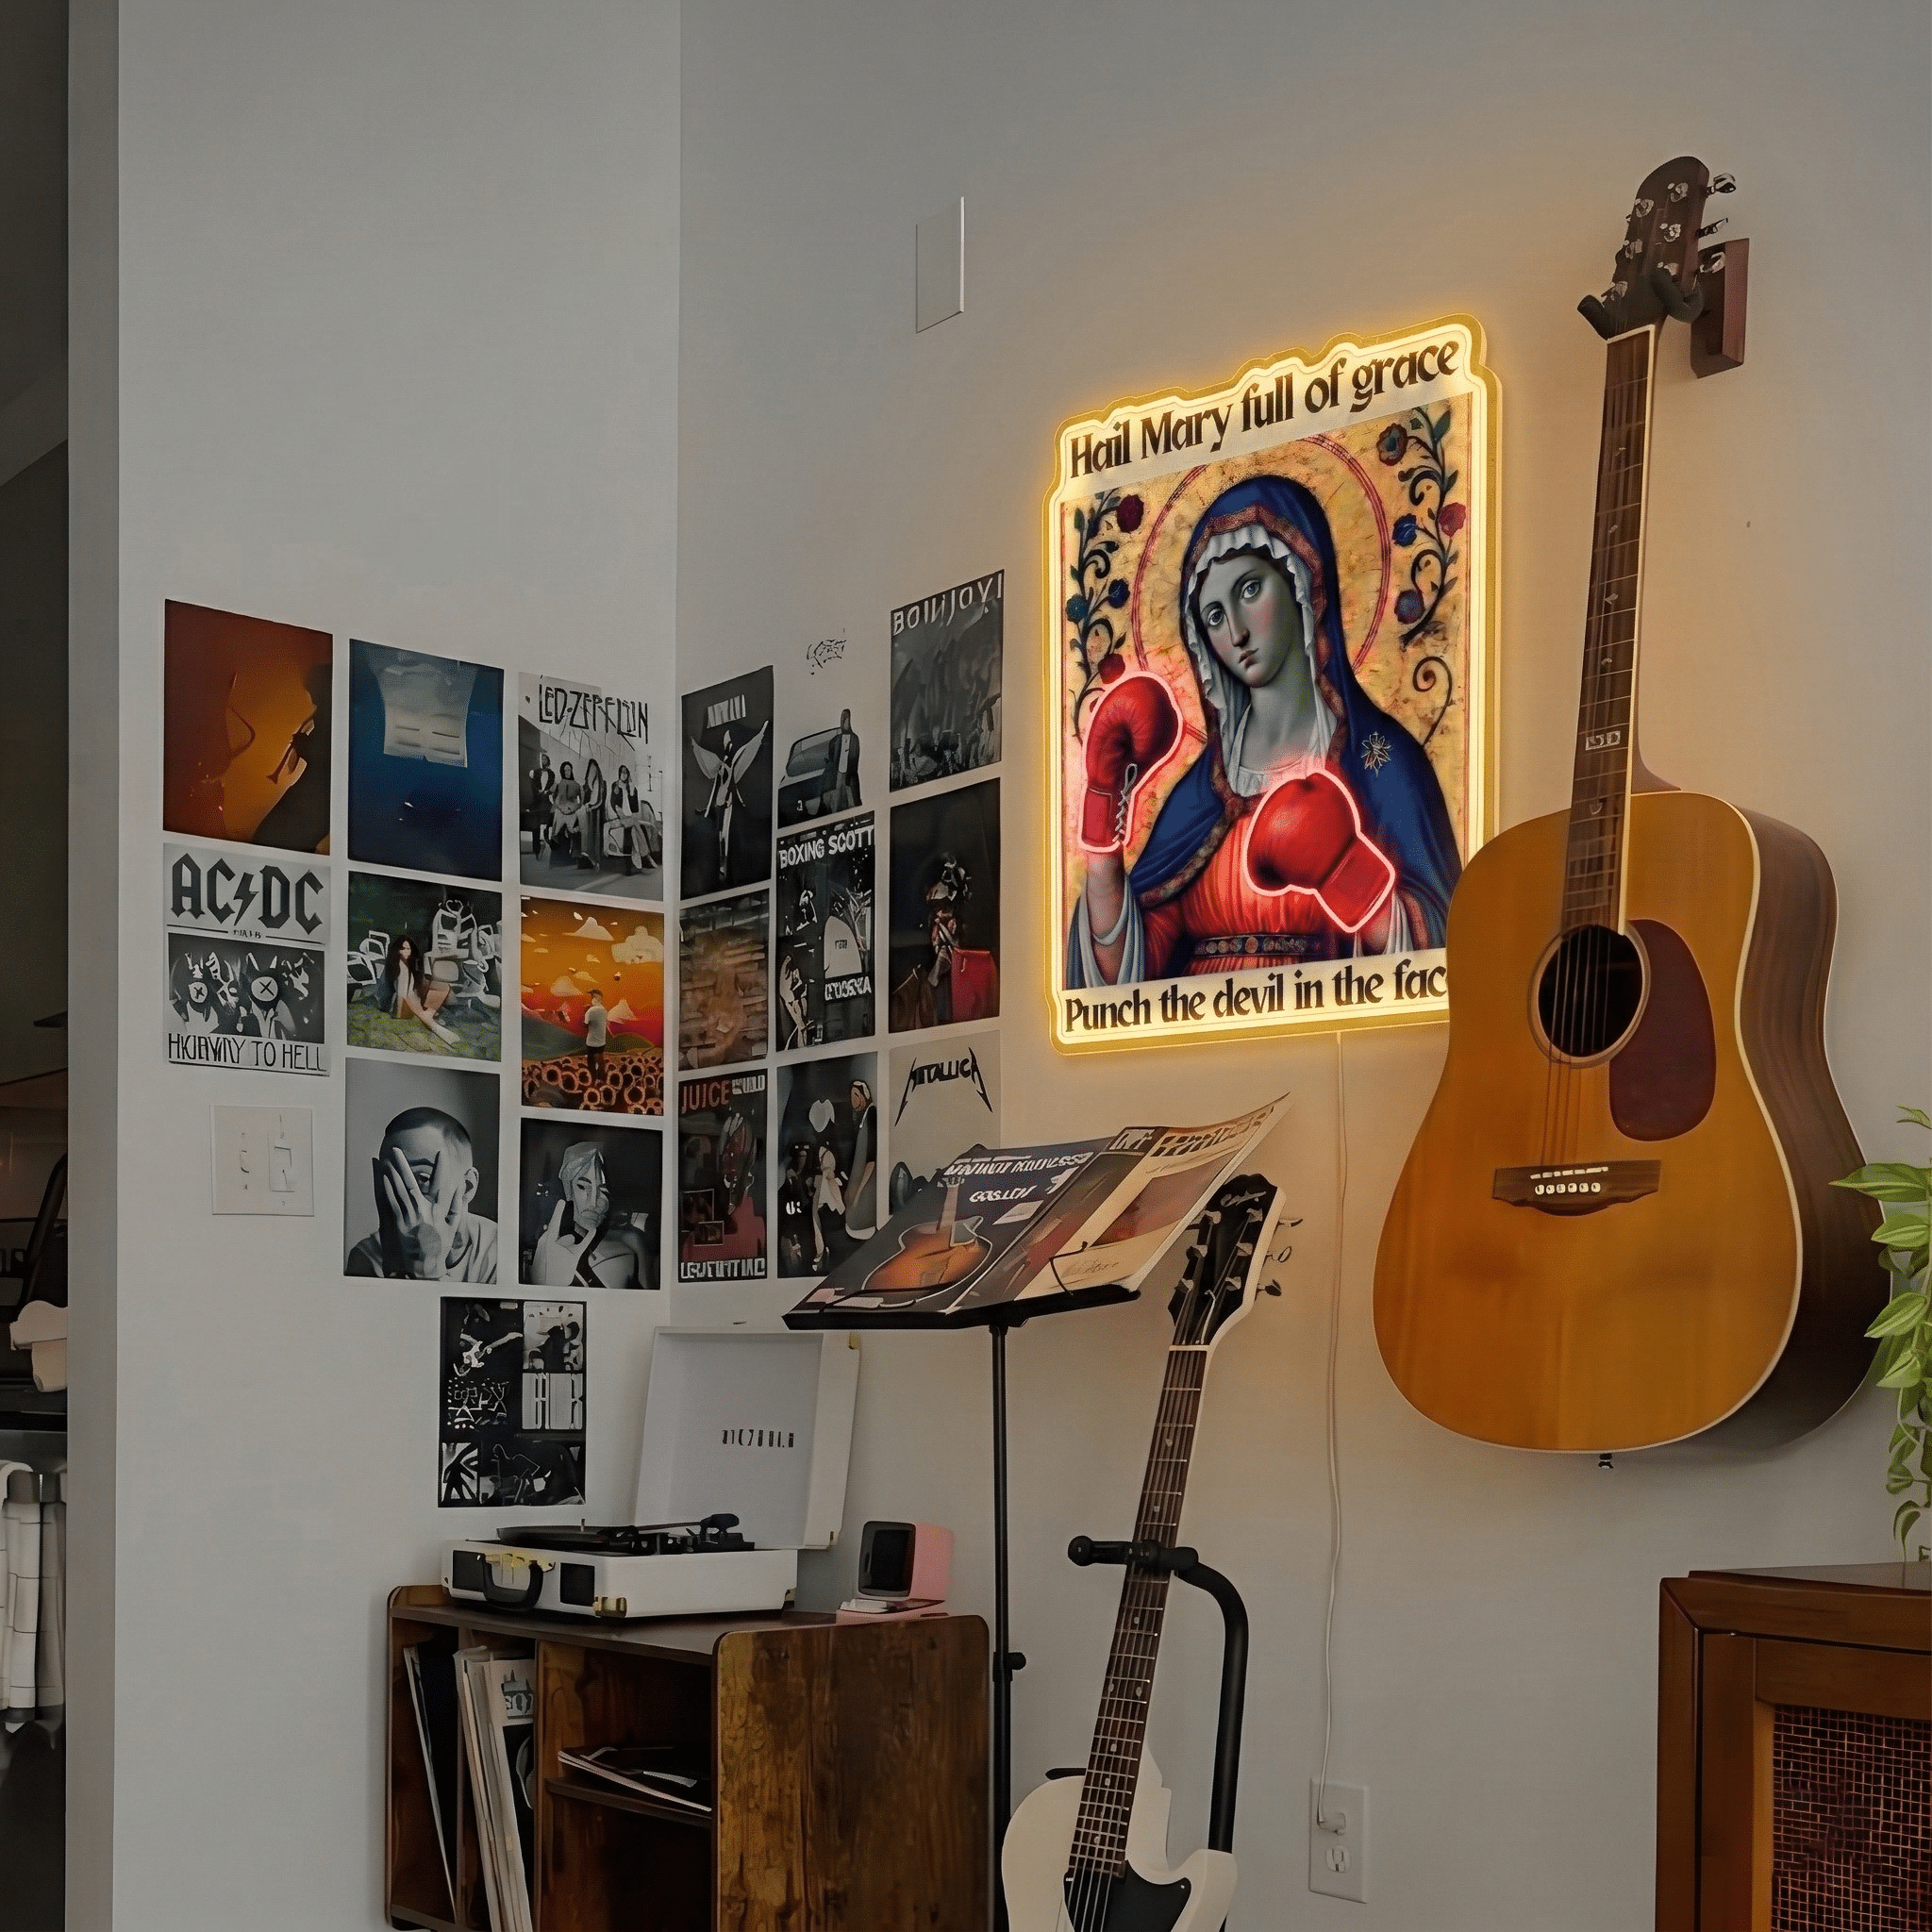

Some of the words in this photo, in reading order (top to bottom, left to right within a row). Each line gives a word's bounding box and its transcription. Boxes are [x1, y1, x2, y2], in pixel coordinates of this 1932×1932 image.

[1070, 419, 1131, 478] Hail
[1141, 402, 1232, 459] Mary
[1241, 372, 1295, 432] full
[1304, 357, 1348, 413] of
[1350, 341, 1459, 413] grace
[778, 839, 825, 869] BOXING
[828, 824, 874, 855] SCOTT
[1065, 989, 1151, 1033] Punch
[1158, 985, 1207, 1023] the
[1213, 973, 1285, 1018] devil
[1293, 969, 1323, 1010] in
[1331, 965, 1384, 1007] the
[1392, 958, 1448, 1001] fac
[251, 1041, 276, 1067] TO
[282, 1043, 327, 1073] HELL
[681, 1080, 730, 1114] JUICE
